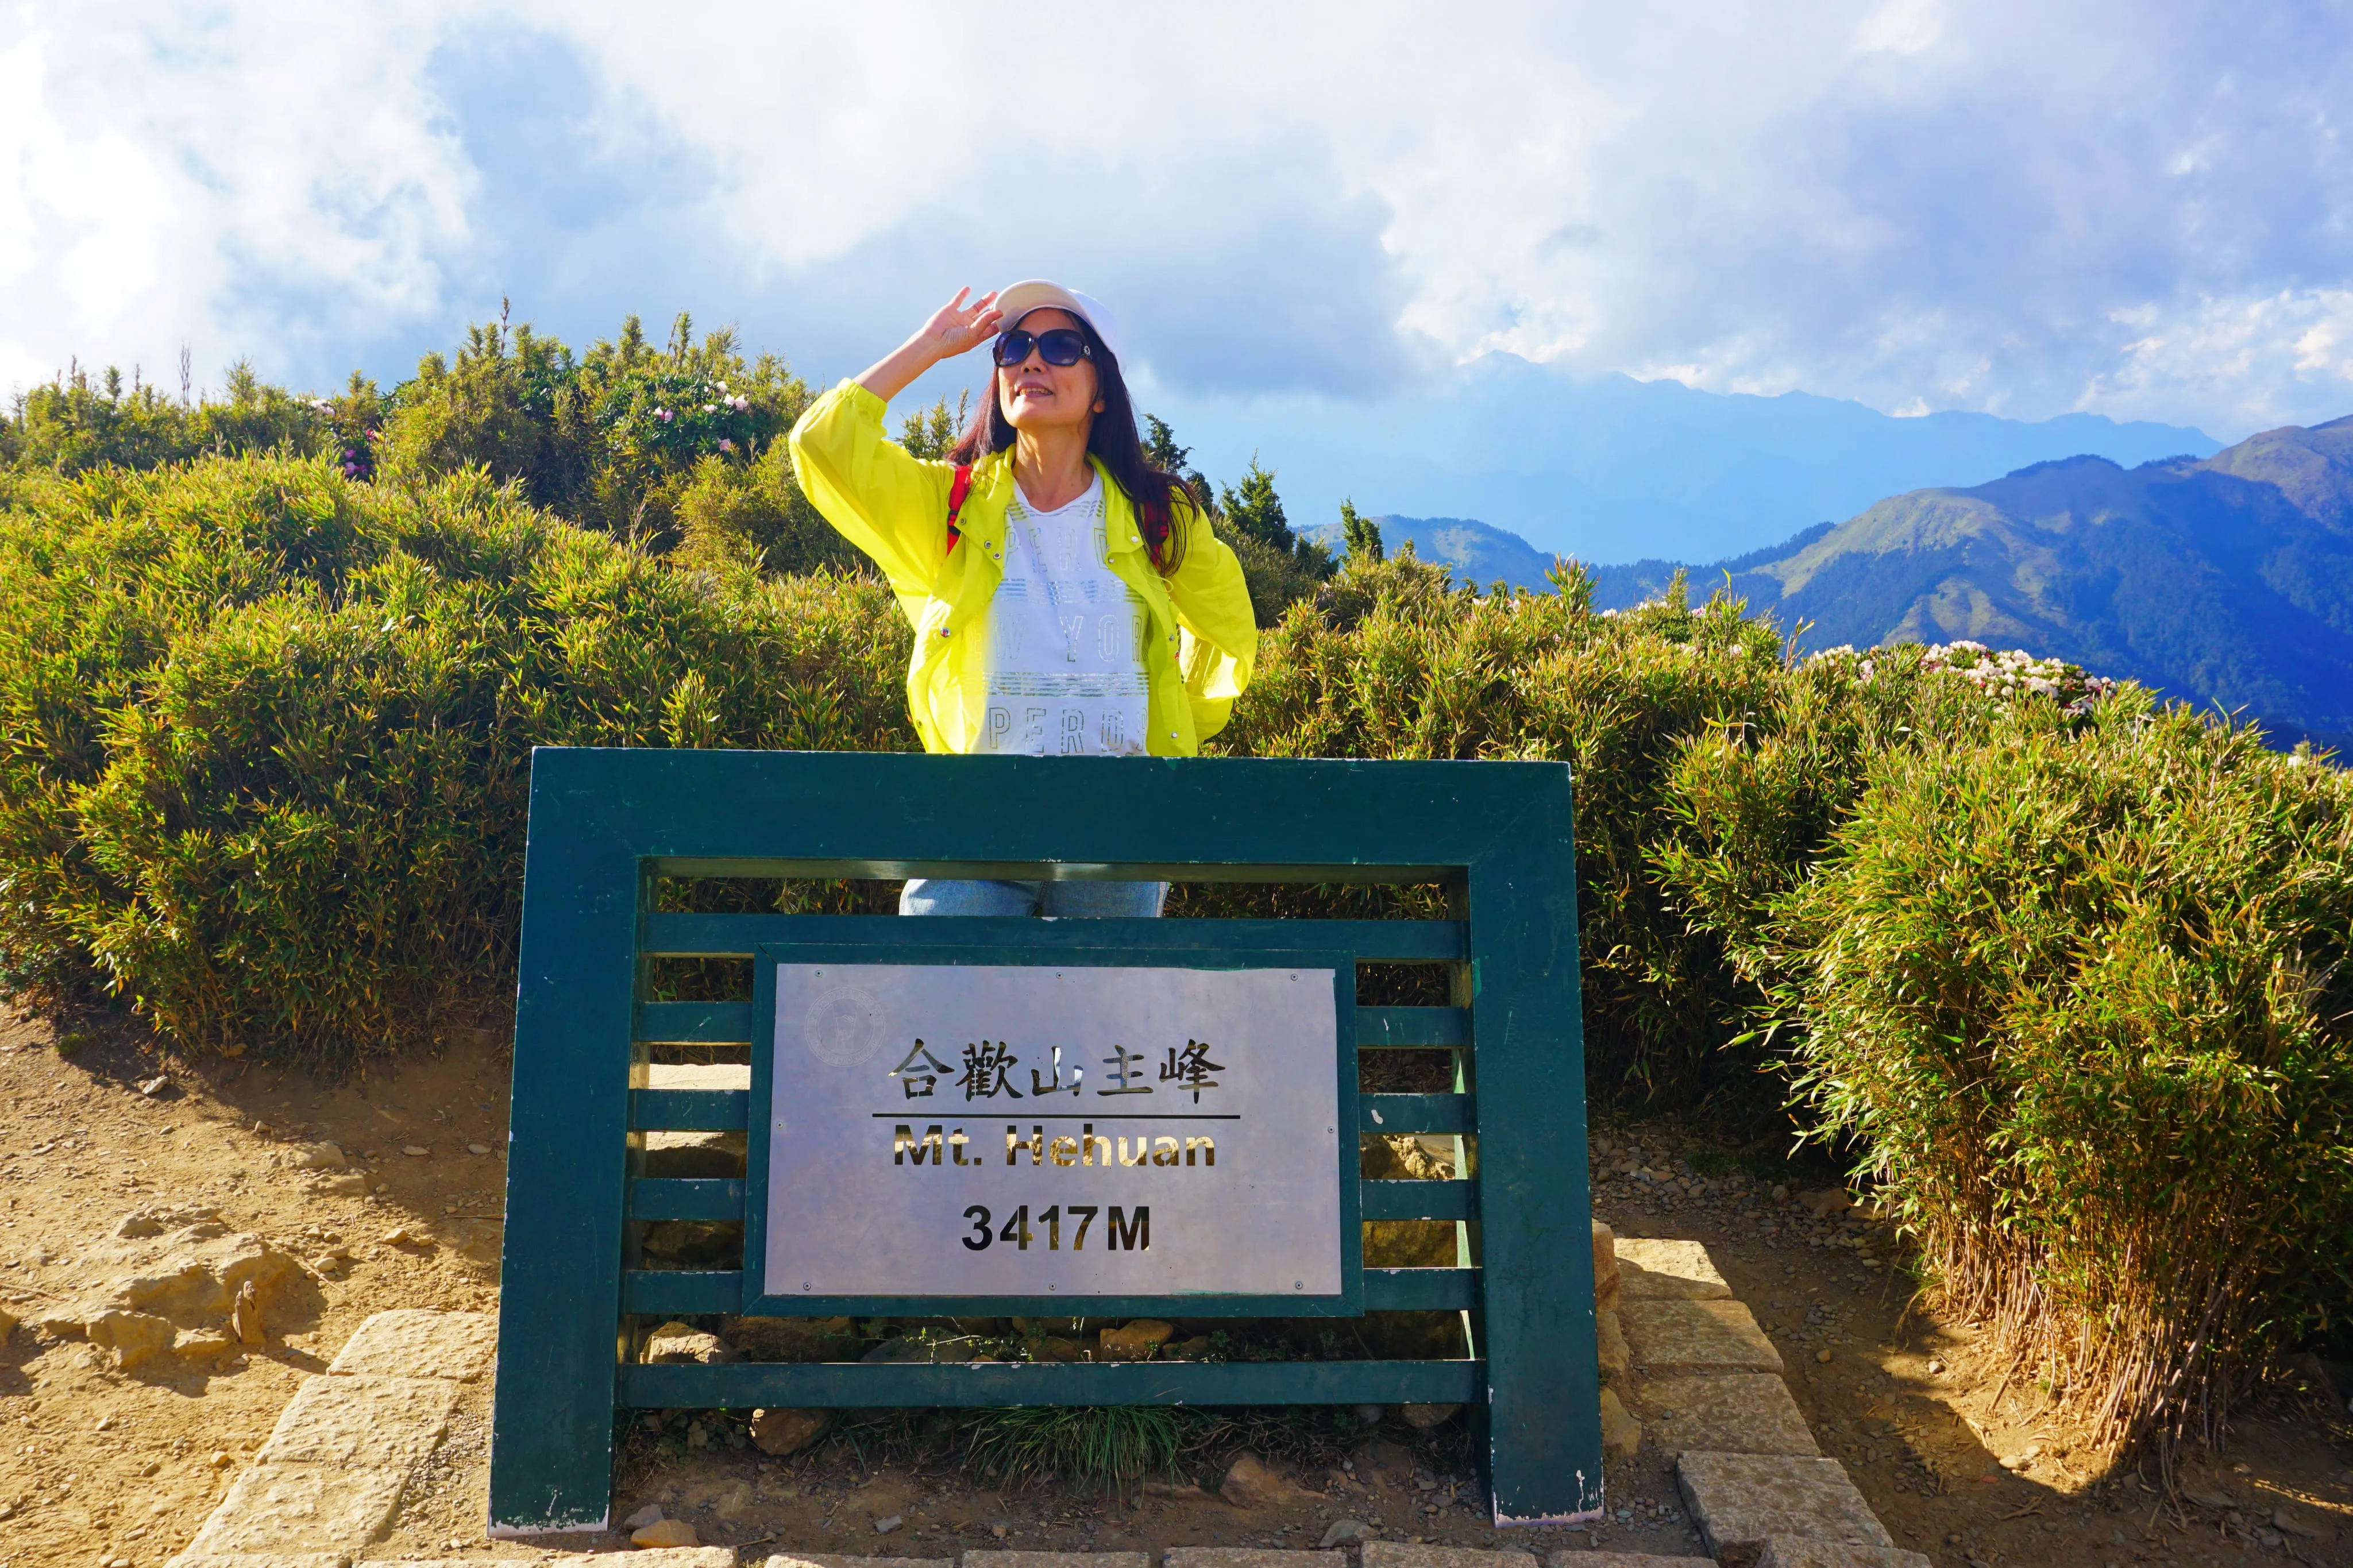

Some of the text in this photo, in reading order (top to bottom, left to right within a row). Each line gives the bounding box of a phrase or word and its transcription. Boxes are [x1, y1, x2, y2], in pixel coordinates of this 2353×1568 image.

[889, 1038, 1226, 1103] 合歡山主峰
[893, 1124, 1215, 1167] Mt. Hehuan
[962, 1204, 1150, 1251] 3417M
